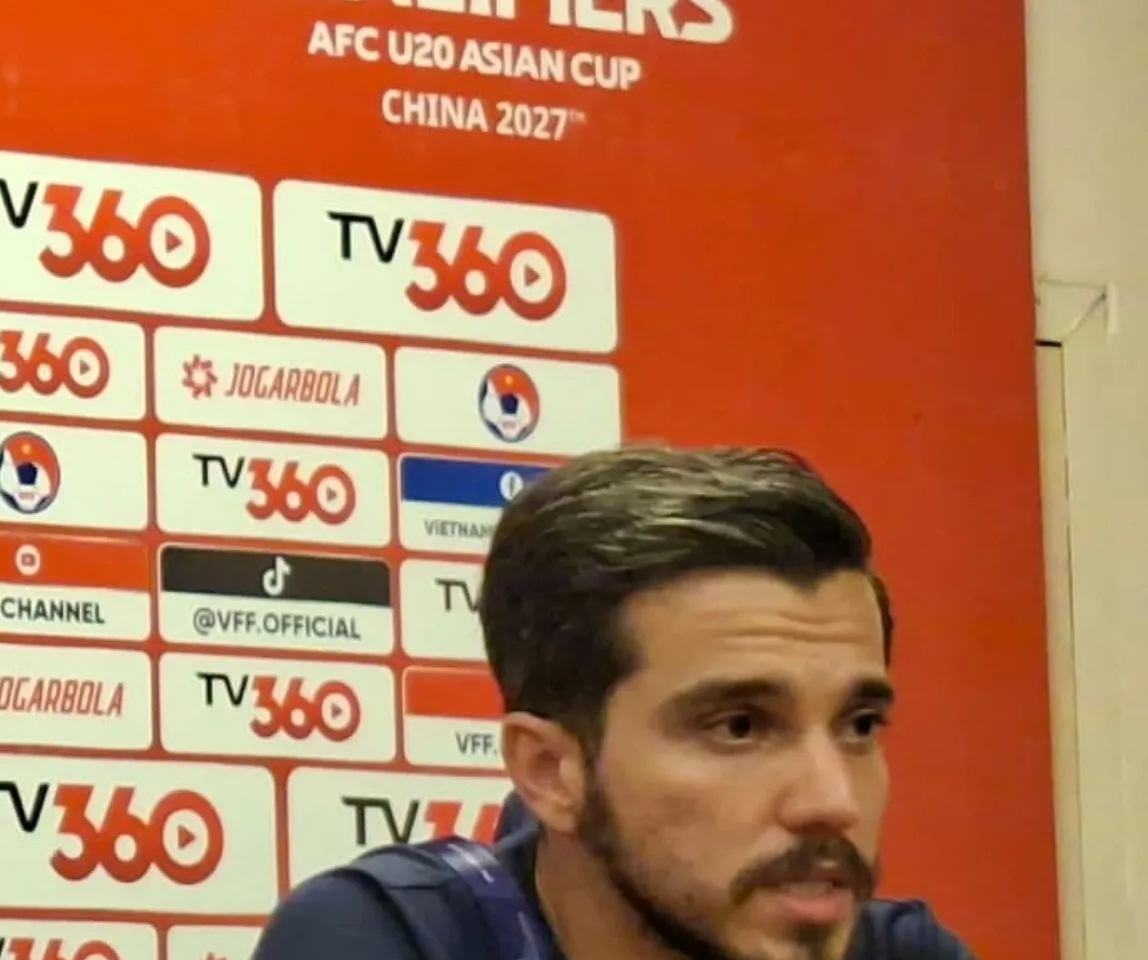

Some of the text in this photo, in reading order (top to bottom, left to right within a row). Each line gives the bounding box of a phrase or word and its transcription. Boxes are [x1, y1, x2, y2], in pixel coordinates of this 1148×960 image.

[308, 21, 379, 61] AFC
[388, 30, 454, 70] U20
[460, 39, 565, 82] ASIAN
[570, 52, 642, 90] CUP
[382, 89, 488, 132] CHINA
[327, 210, 567, 321] TV360
[225, 361, 362, 407] JOGARBOLA
[192, 453, 356, 525] TV360
[0, 597, 106, 625] CHANNEL
[192, 607, 362, 640] @VFF.OFFICIAL
[196, 672, 362, 743] TV360
